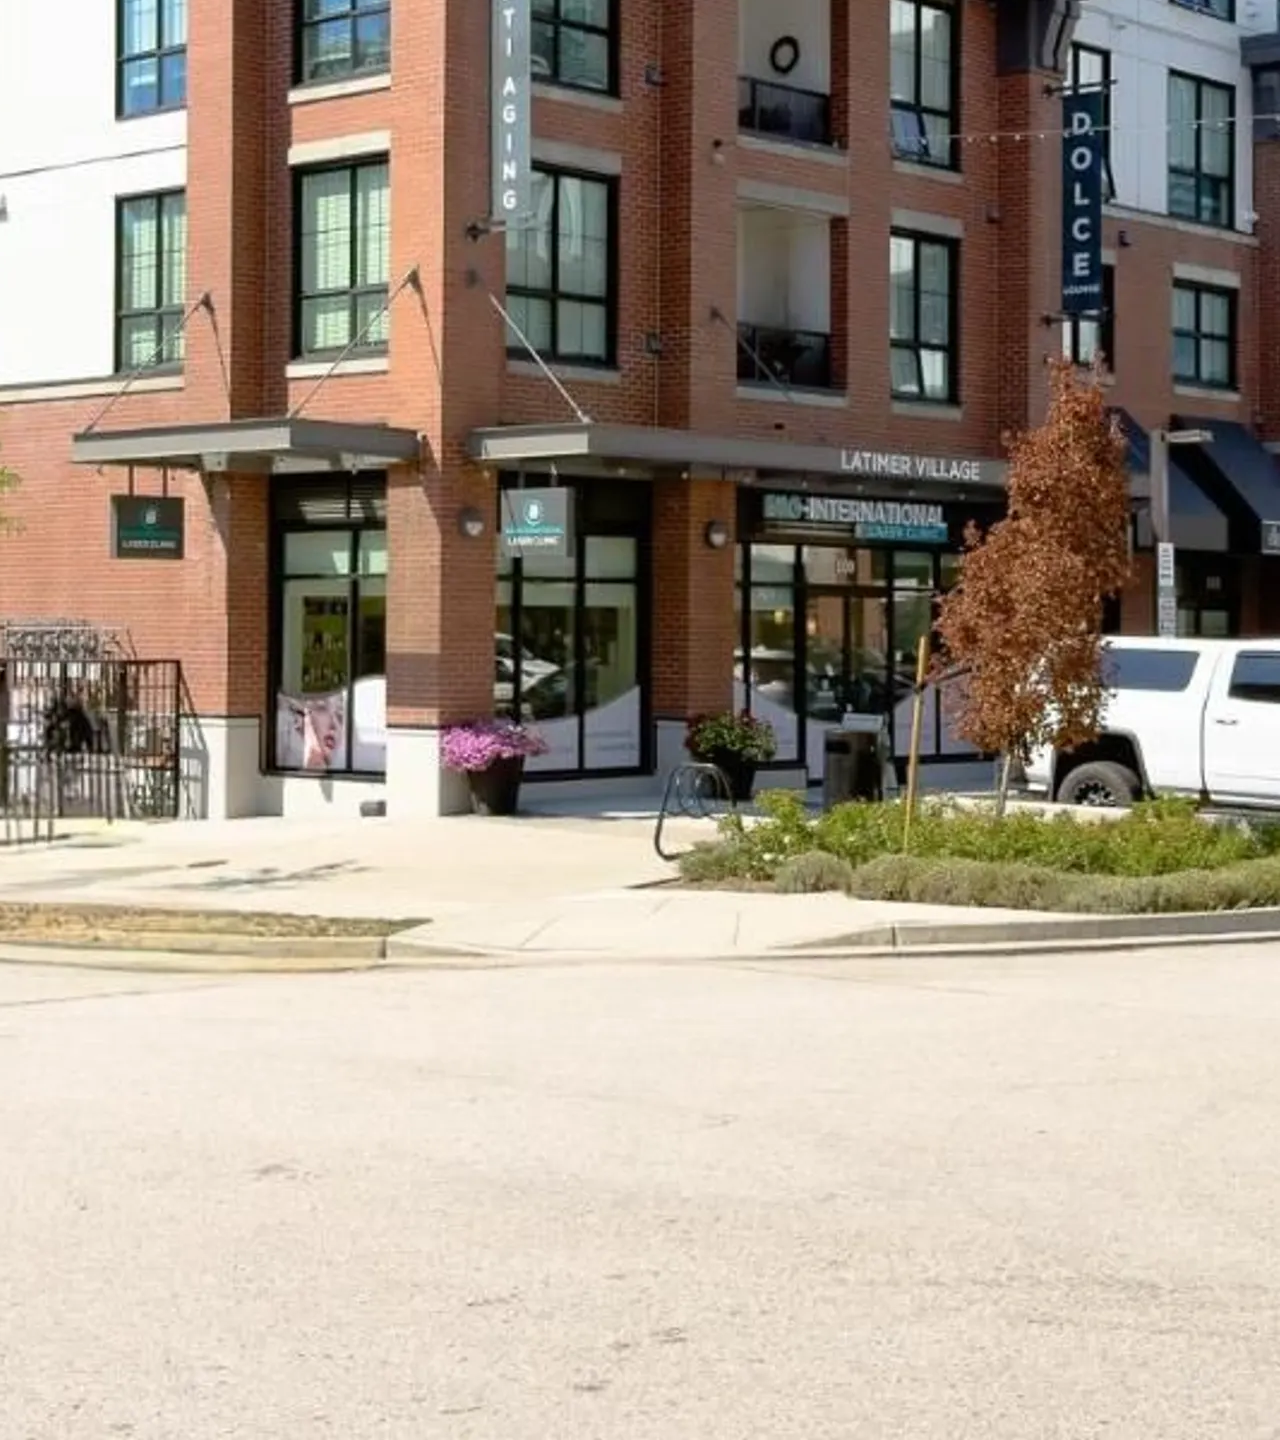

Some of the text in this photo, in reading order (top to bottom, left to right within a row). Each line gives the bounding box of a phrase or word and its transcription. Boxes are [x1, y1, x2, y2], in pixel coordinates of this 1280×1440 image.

[502, 76, 517, 210] AGING
[1071, 112, 1093, 278] DOLCE
[840, 450, 981, 481] LATIMER VILLAGE
